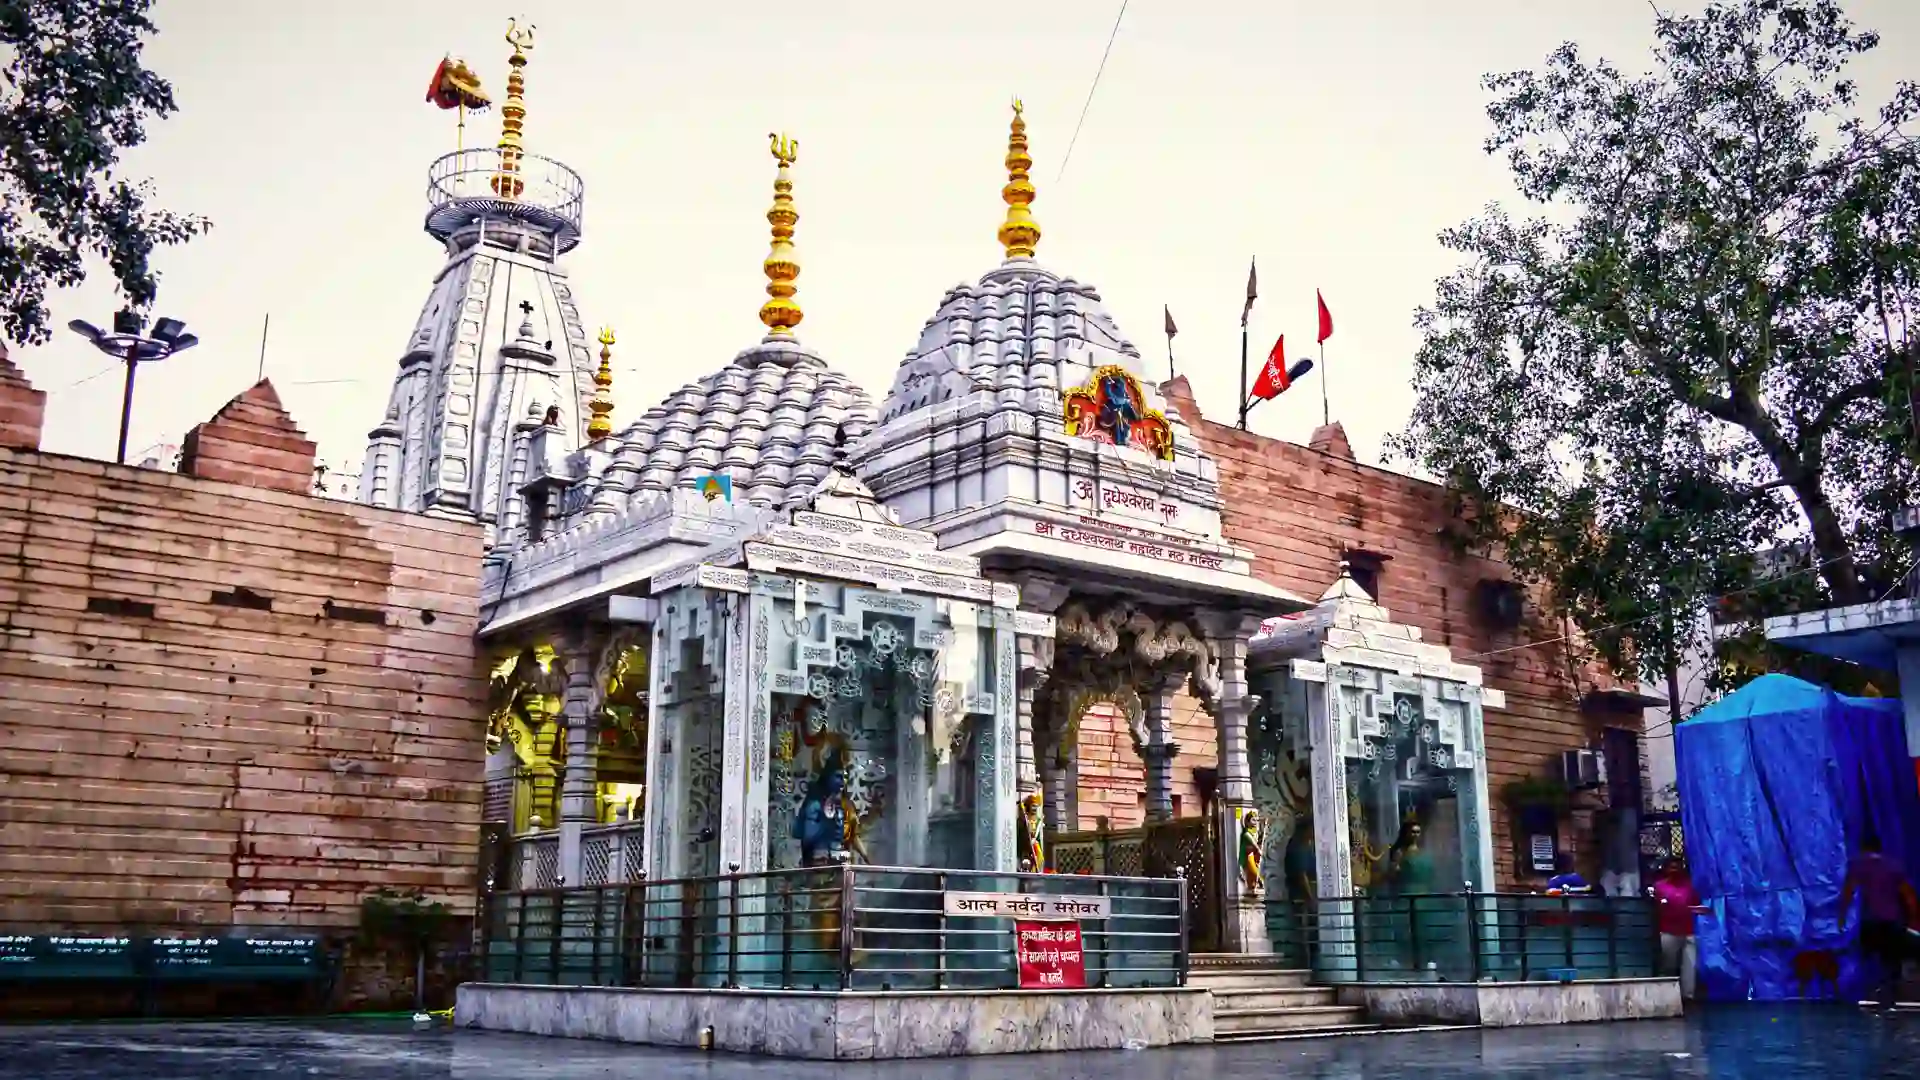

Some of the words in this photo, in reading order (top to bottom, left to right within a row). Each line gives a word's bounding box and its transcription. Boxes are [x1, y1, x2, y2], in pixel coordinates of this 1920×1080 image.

[957, 898, 997, 914] आत्म
[1006, 897, 1045, 915] नर्वदा
[1054, 899, 1100, 914] सरोवर
